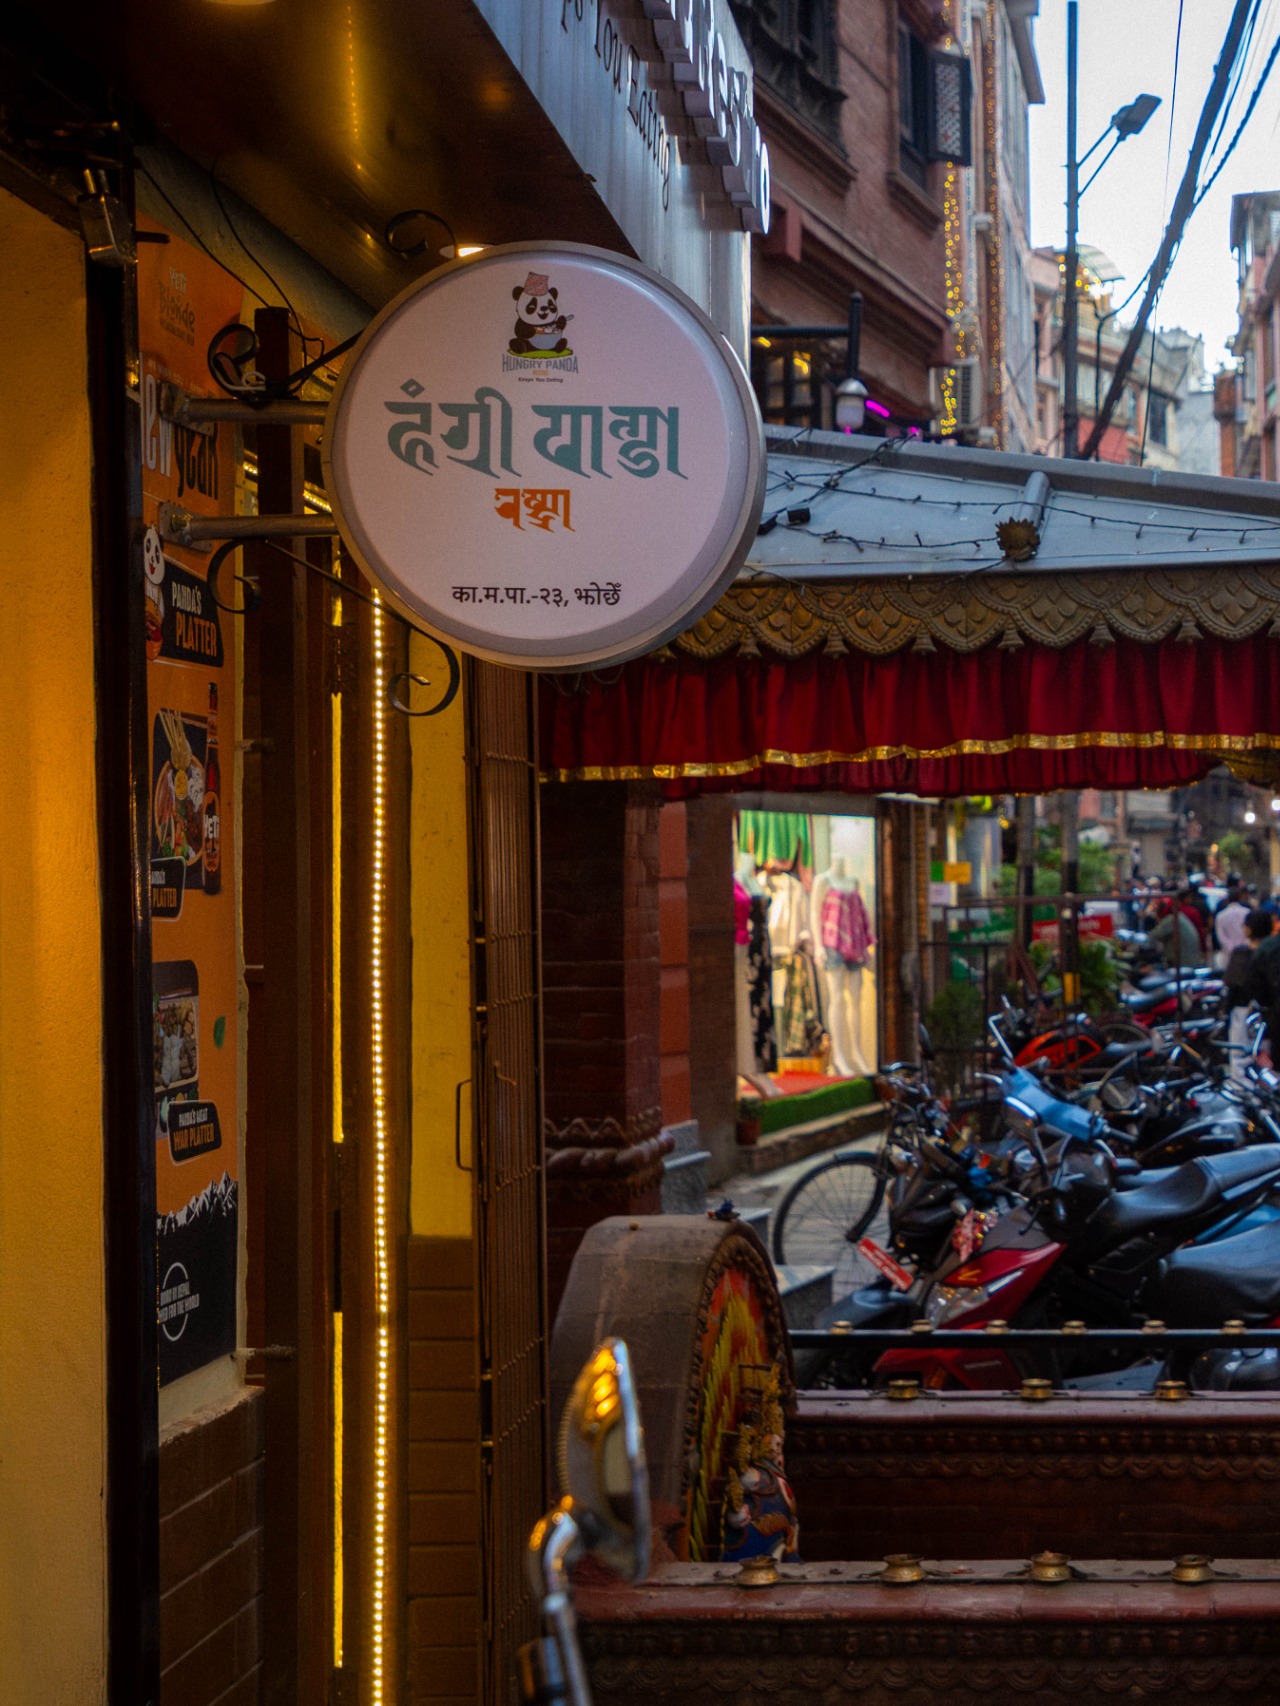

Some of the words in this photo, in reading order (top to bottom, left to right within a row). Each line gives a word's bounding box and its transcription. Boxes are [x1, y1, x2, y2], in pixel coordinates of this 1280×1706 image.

[502, 354, 543, 373] HUNGRY
[545, 355, 579, 374] PANDA
[175, 610, 217, 657] PLATTER
